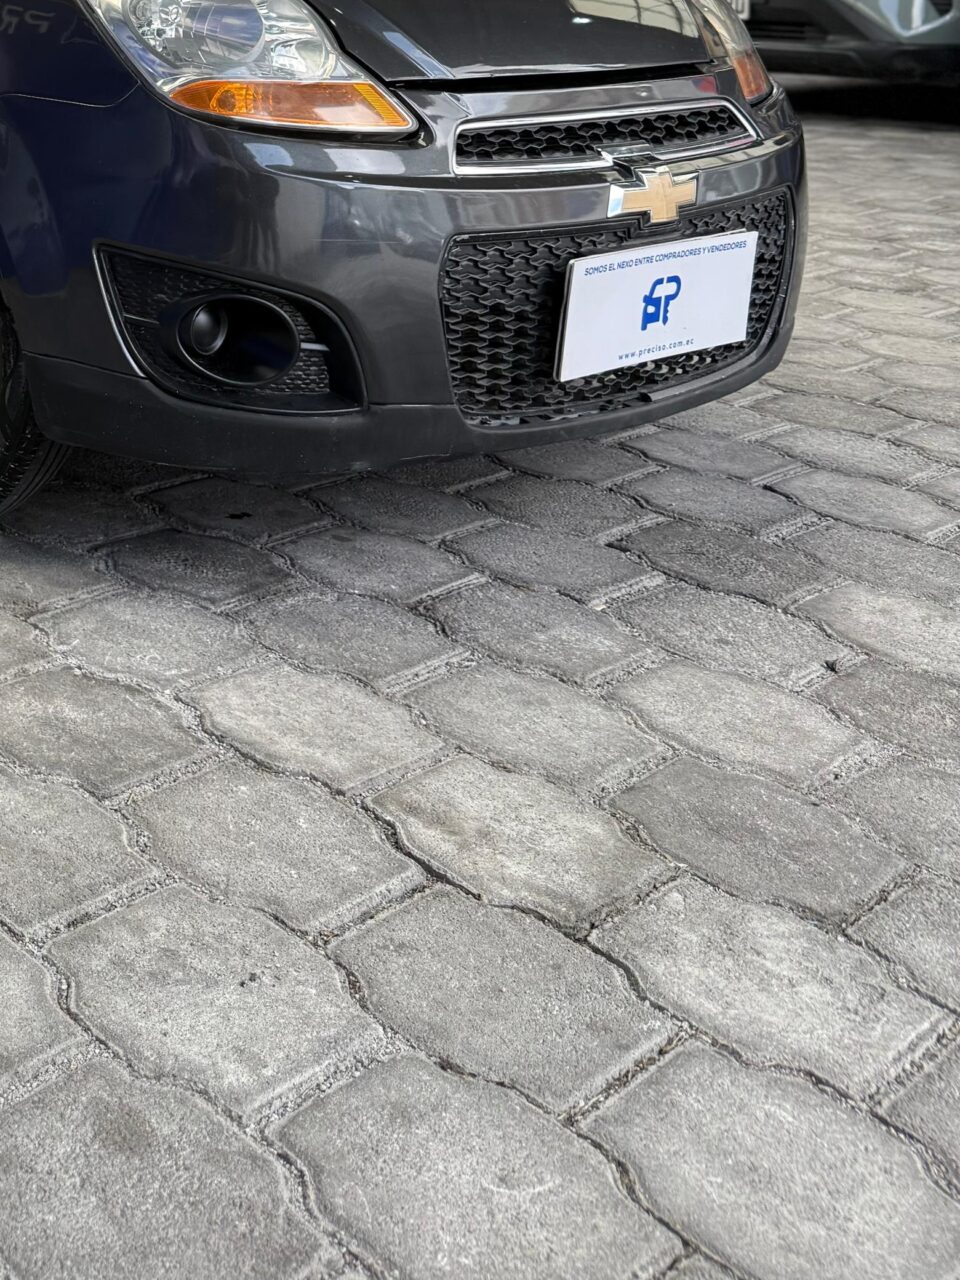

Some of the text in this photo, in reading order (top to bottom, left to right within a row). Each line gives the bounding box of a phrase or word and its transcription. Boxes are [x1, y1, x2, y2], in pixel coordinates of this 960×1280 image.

[584, 240, 747, 276] SOMOS EL NEXO ENTRE COMPRADORES Y VENDEDORES
[618, 338, 694, 360] www.preciso.com.ec
